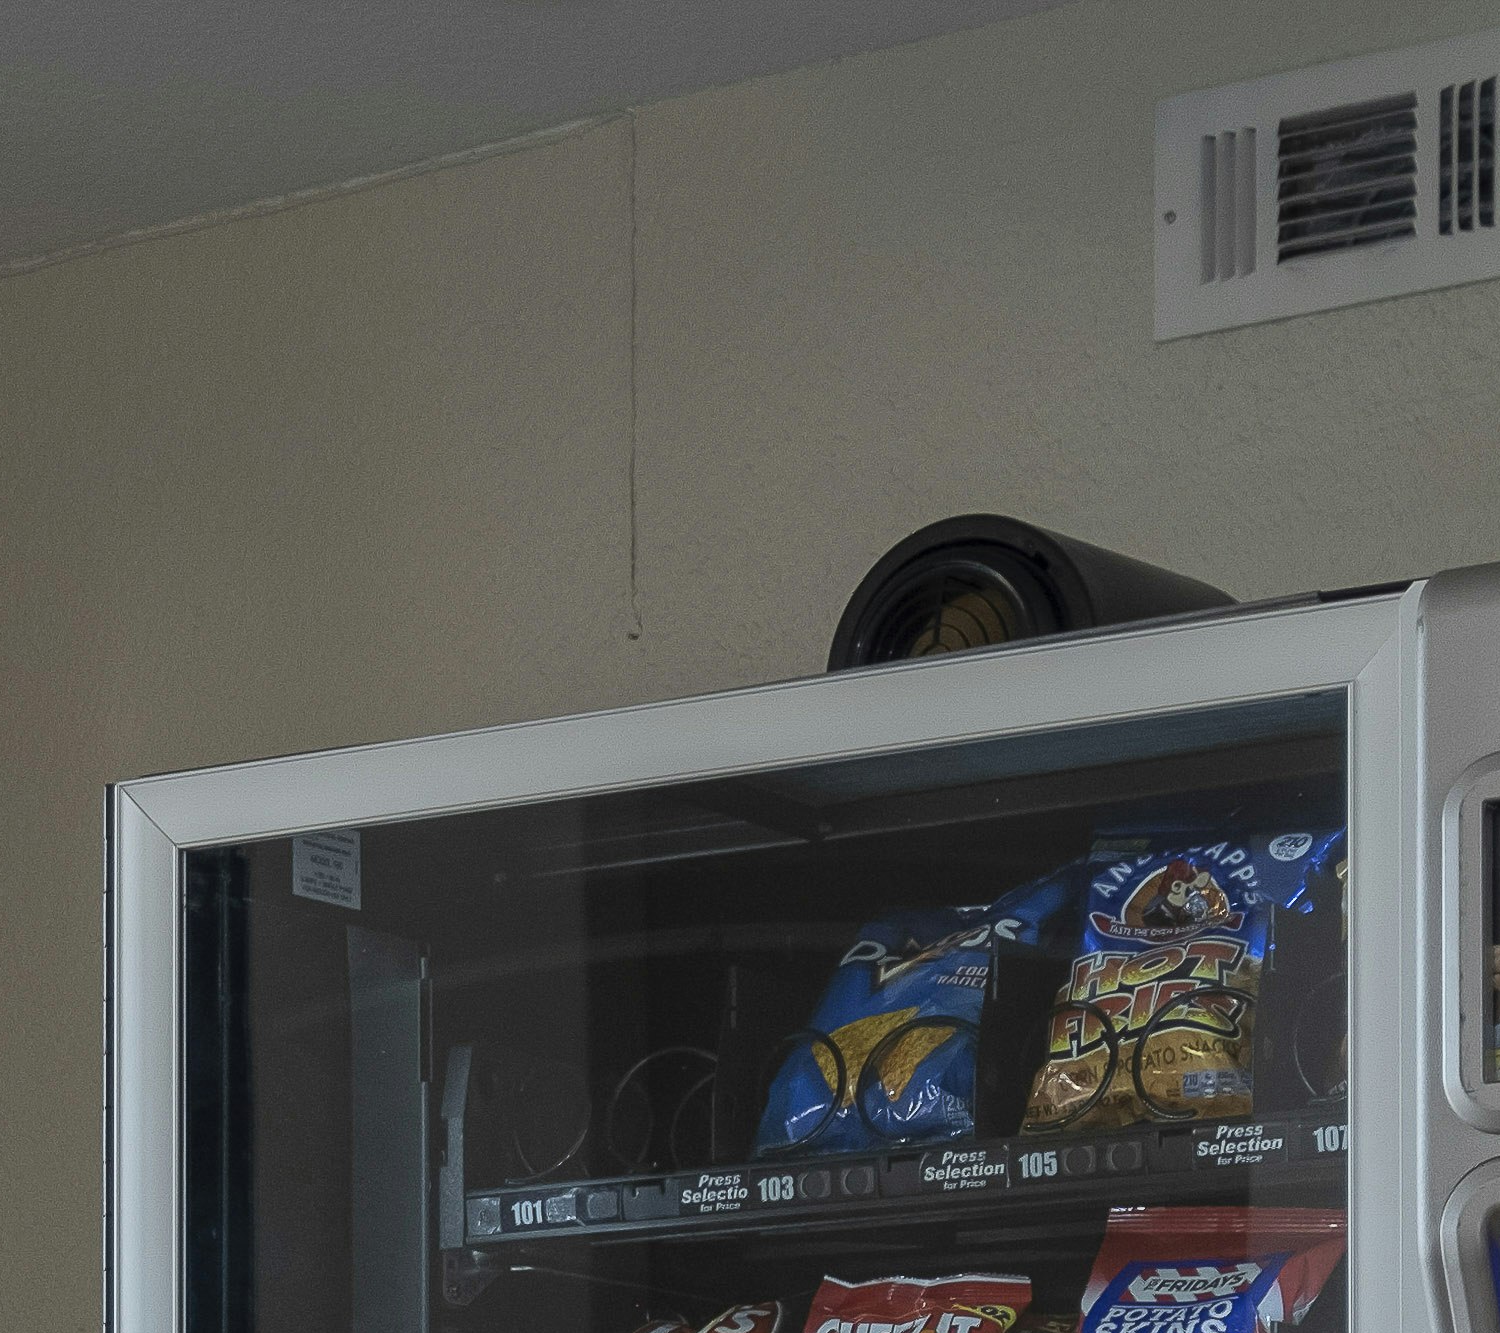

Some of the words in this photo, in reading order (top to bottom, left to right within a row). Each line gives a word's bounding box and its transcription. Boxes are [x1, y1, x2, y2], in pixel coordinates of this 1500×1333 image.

[954, 965, 990, 977] COO
[1068, 939, 1250, 1001] HOT
[1045, 979, 1250, 1064] FRIES
[1216, 1126, 1264, 1144] Press
[942, 1151, 988, 1166] Press
[1196, 1137, 1284, 1159] Selection
[1019, 1151, 1059, 1180] 105
[1234, 1154, 1264, 1165] Price
[699, 1174, 742, 1188] Press
[923, 1163, 1006, 1181] Selection
[682, 1186, 749, 1204] Selectio
[758, 1176, 796, 1203] 103
[511, 1200, 543, 1225] 101
[1157, 1272, 1249, 1295] FRIDAYS
[1101, 1299, 1233, 1323] POTATO
